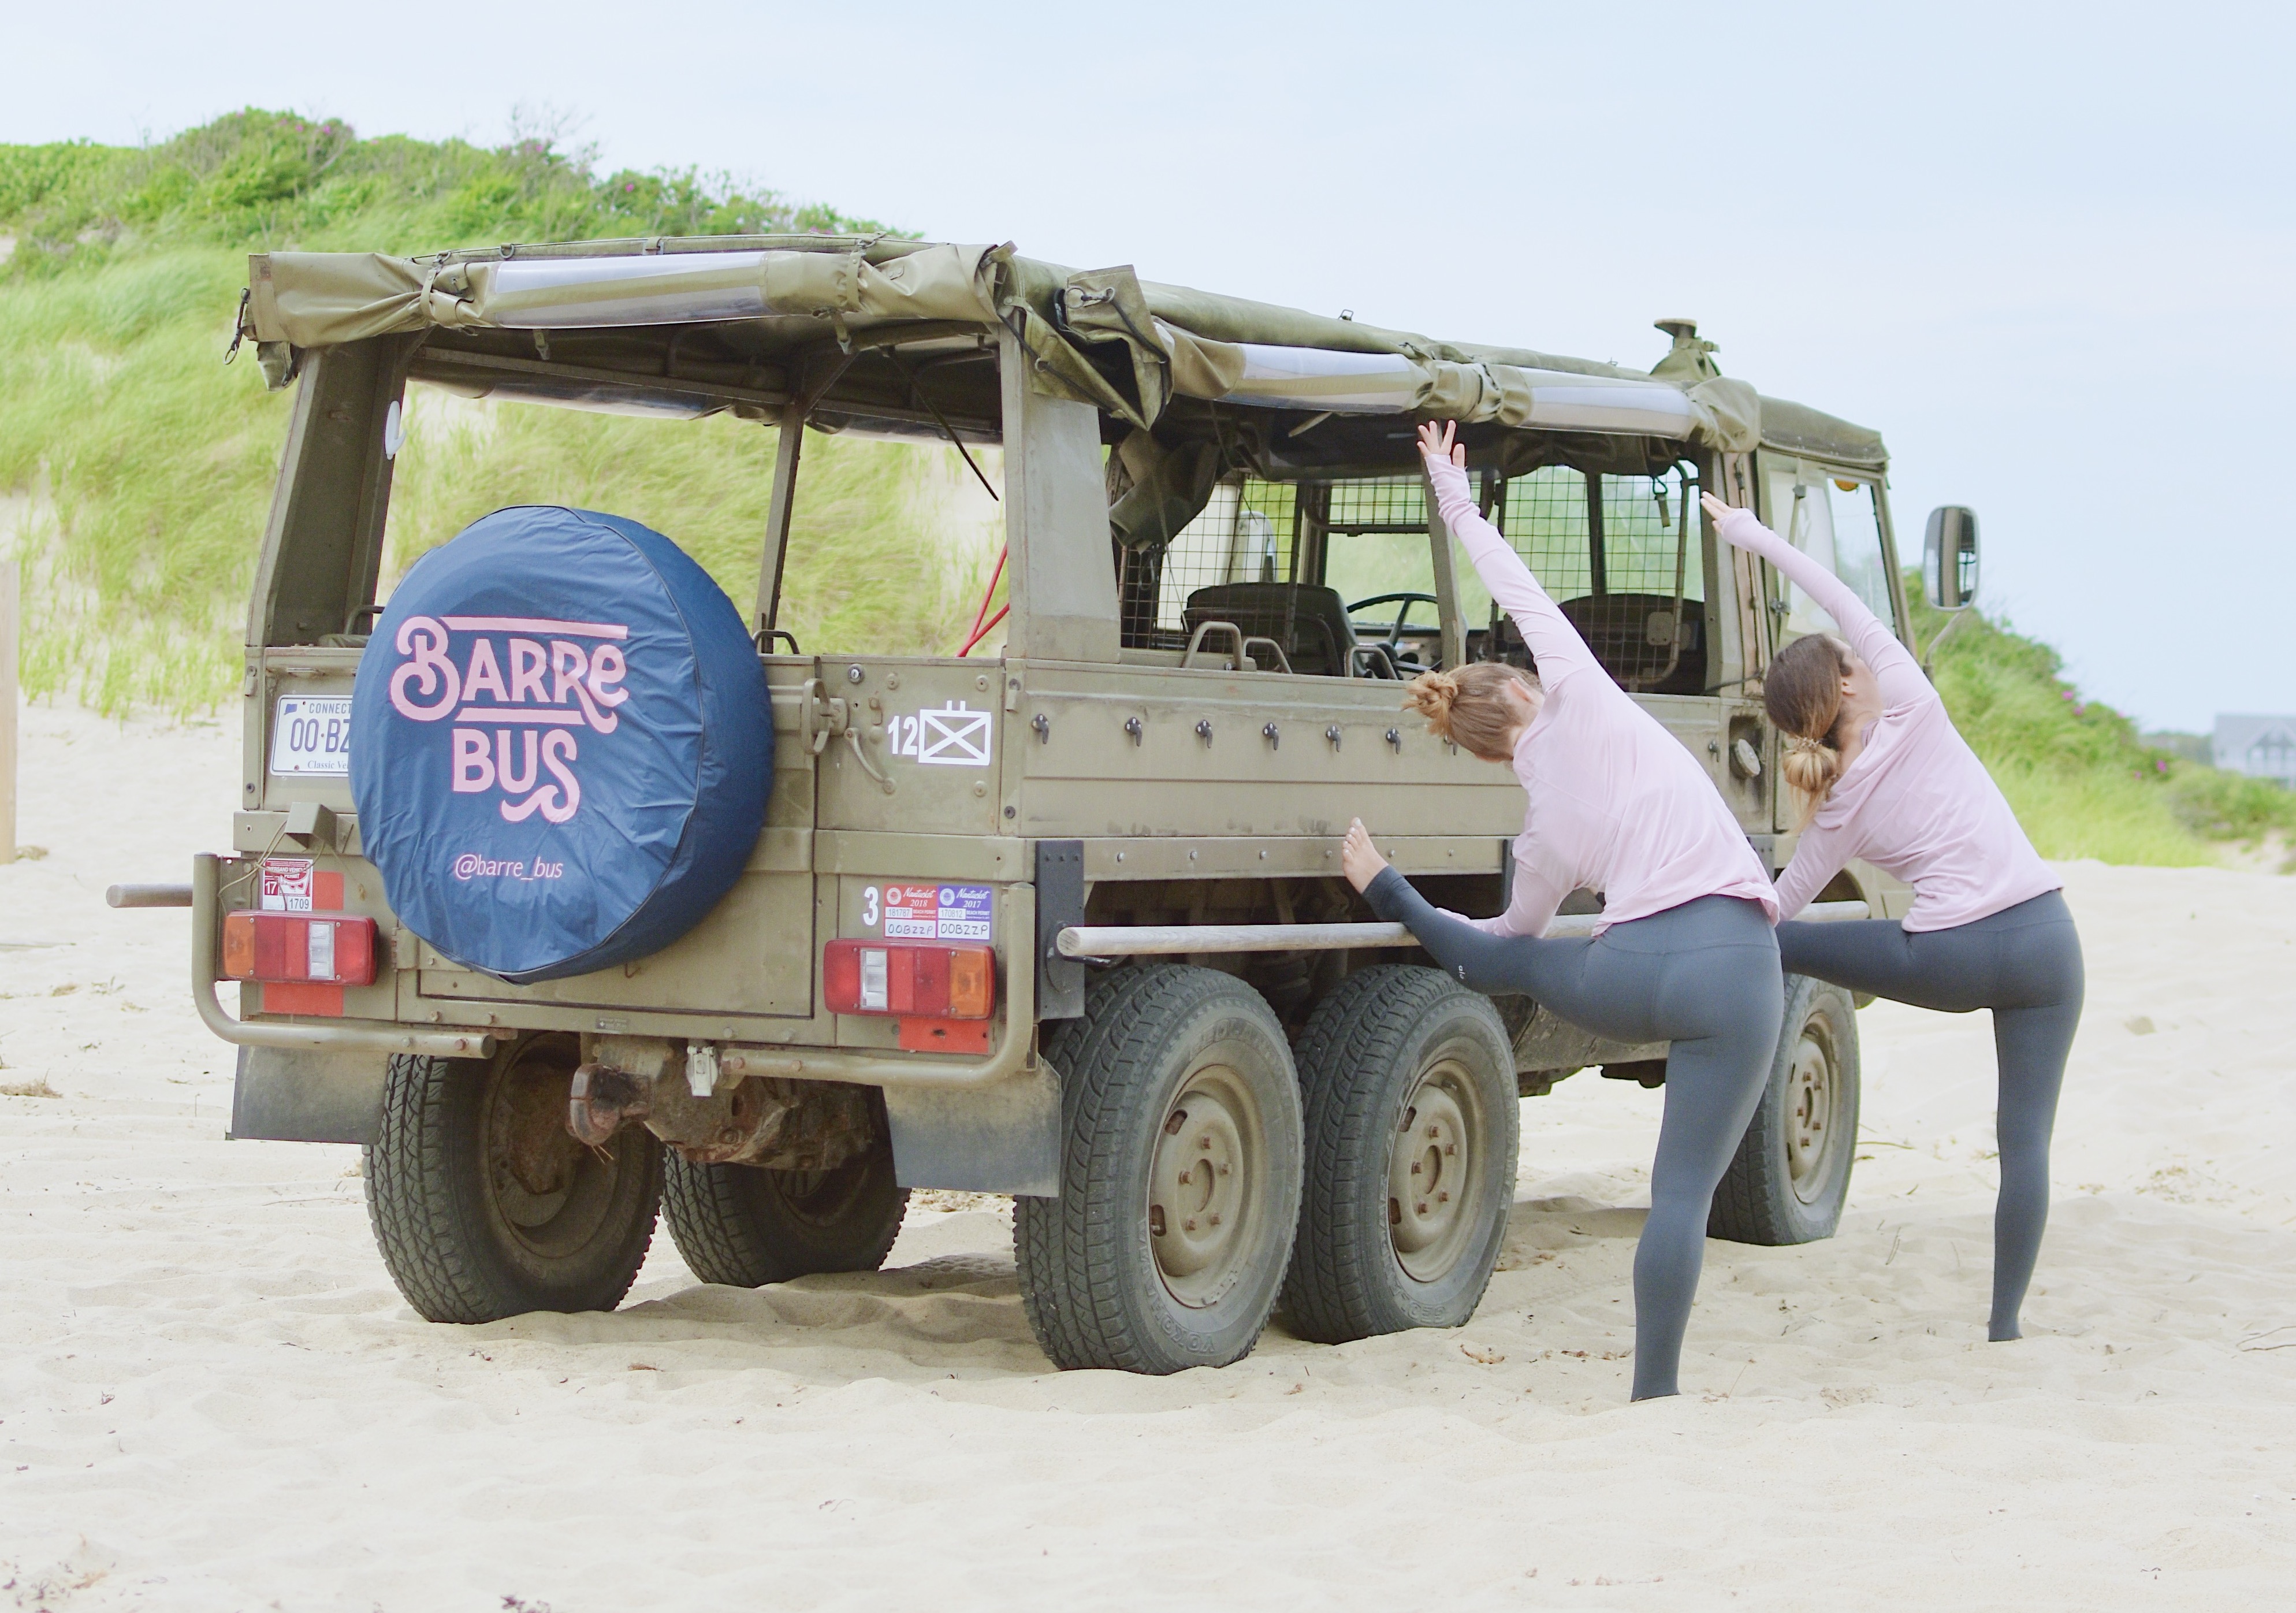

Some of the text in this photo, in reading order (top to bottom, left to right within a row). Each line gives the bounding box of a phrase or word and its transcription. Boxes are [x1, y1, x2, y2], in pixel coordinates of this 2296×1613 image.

[888, 715, 918, 755] 12
[307, 760, 335, 769] Classic
[453, 729, 580, 823] BUS
[455, 854, 564, 880] @barre_bus
[843, 881, 855, 894] 17
[903, 887, 936, 898] Nantucket
[956, 887, 991, 900] Nantucket
[289, 898, 309, 909] 1709
[862, 886, 879, 926] 3
[909, 899, 928, 907] 2018
[963, 900, 982, 908] 2017
[889, 908, 910, 917] 181787
[941, 909, 963, 918] 170812
